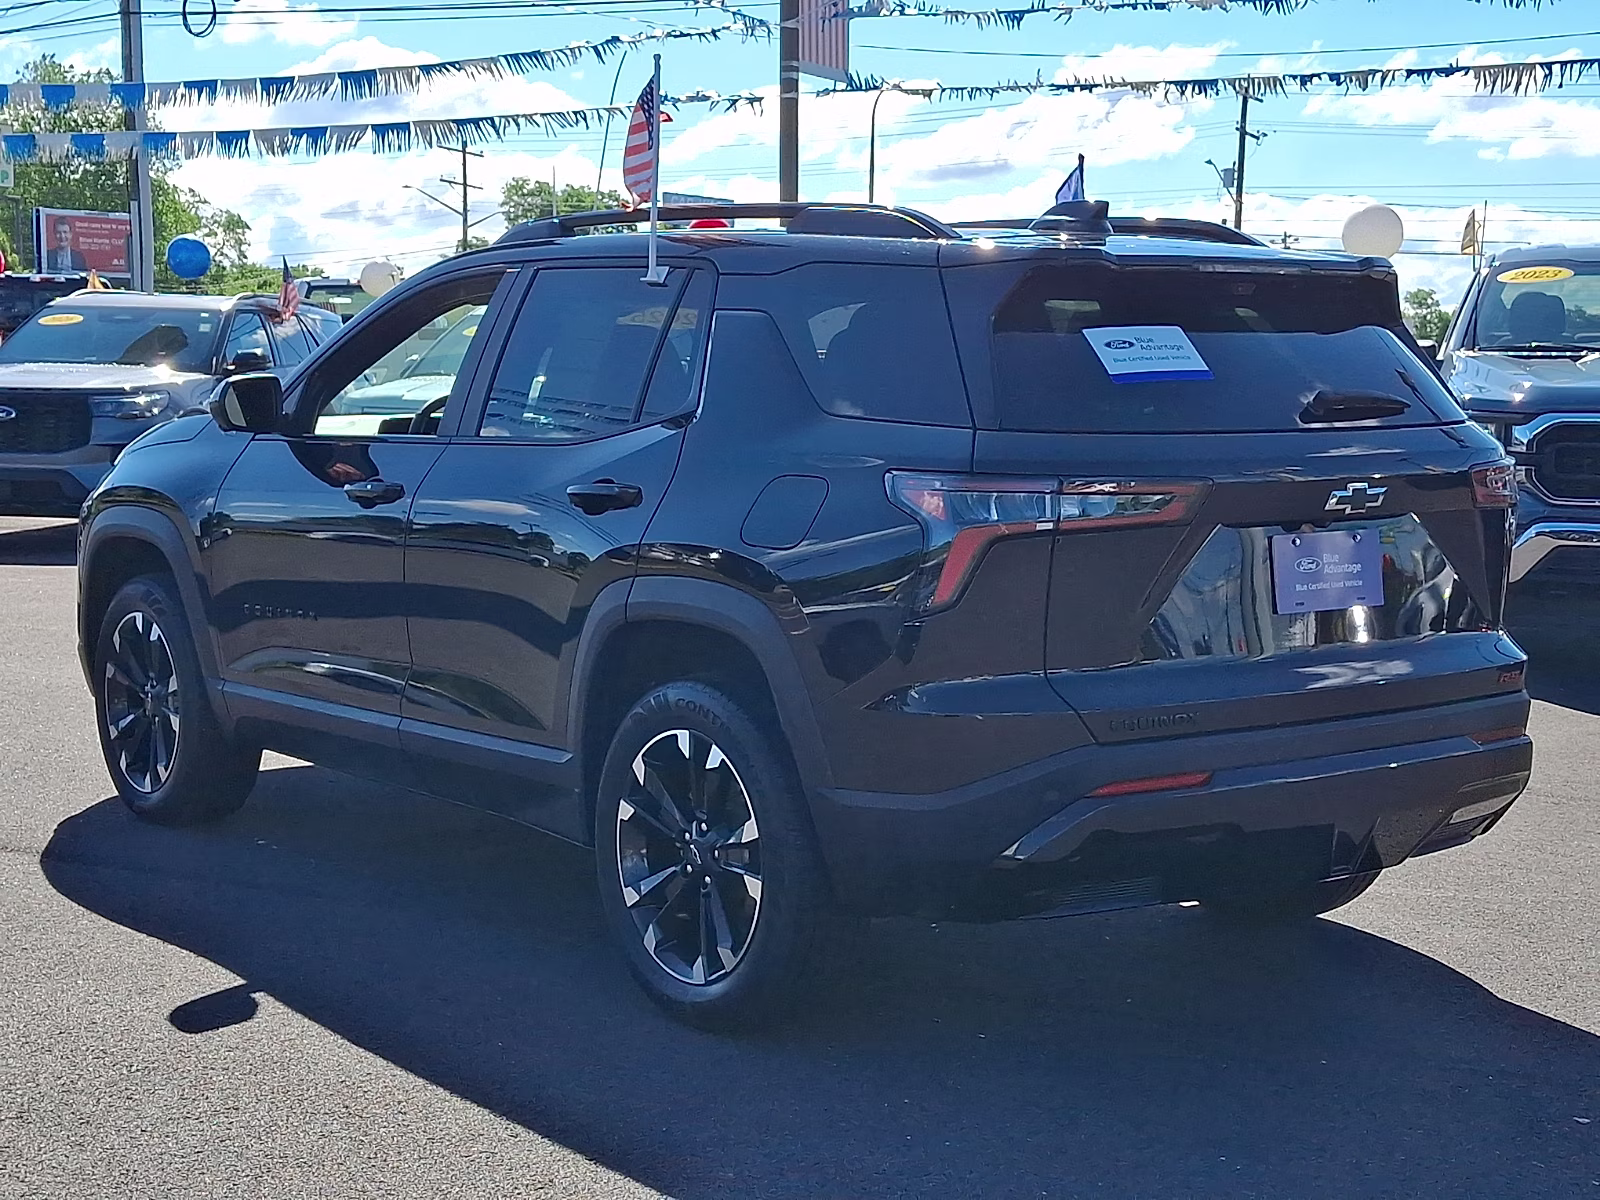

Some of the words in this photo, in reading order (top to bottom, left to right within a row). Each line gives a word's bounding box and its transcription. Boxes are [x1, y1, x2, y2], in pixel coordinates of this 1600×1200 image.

[1509, 269, 1562, 281] 2023
[1134, 336, 1155, 344] Blue
[1140, 344, 1185, 352] Advantage
[1323, 553, 1339, 562] Blue
[1324, 562, 1362, 574] Advantage
[1295, 583, 1307, 592] Blue
[1308, 581, 1330, 591] Certified
[1331, 580, 1344, 589] Used
[1345, 579, 1363, 588] Vehicle
[1109, 711, 1201, 732] EQUINOX
